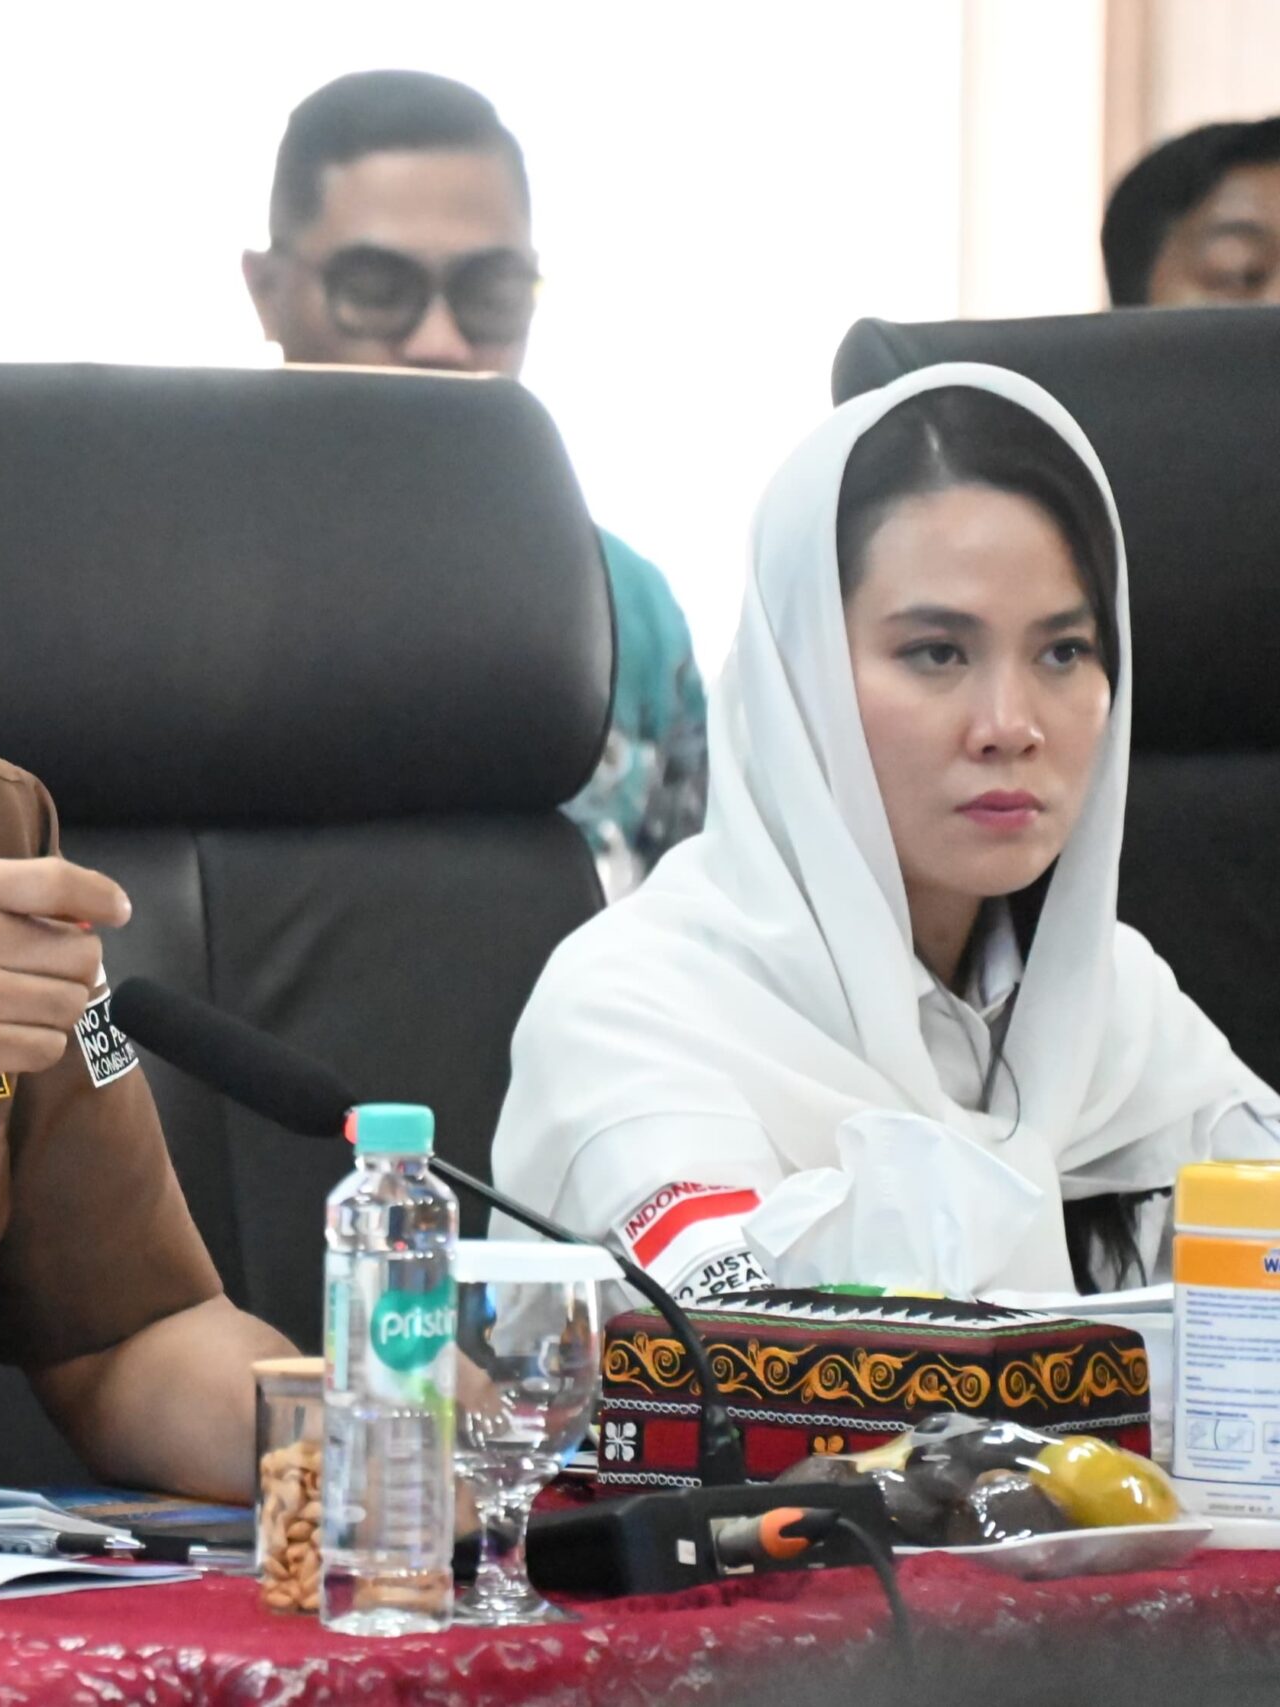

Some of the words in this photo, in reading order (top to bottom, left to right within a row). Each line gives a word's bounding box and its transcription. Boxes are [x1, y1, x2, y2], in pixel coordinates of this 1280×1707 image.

[79, 1009, 99, 1035] NO
[84, 1031, 109, 1060] NO
[625, 1181, 736, 1241] INDONE
[709, 1267, 768, 1295] PEA
